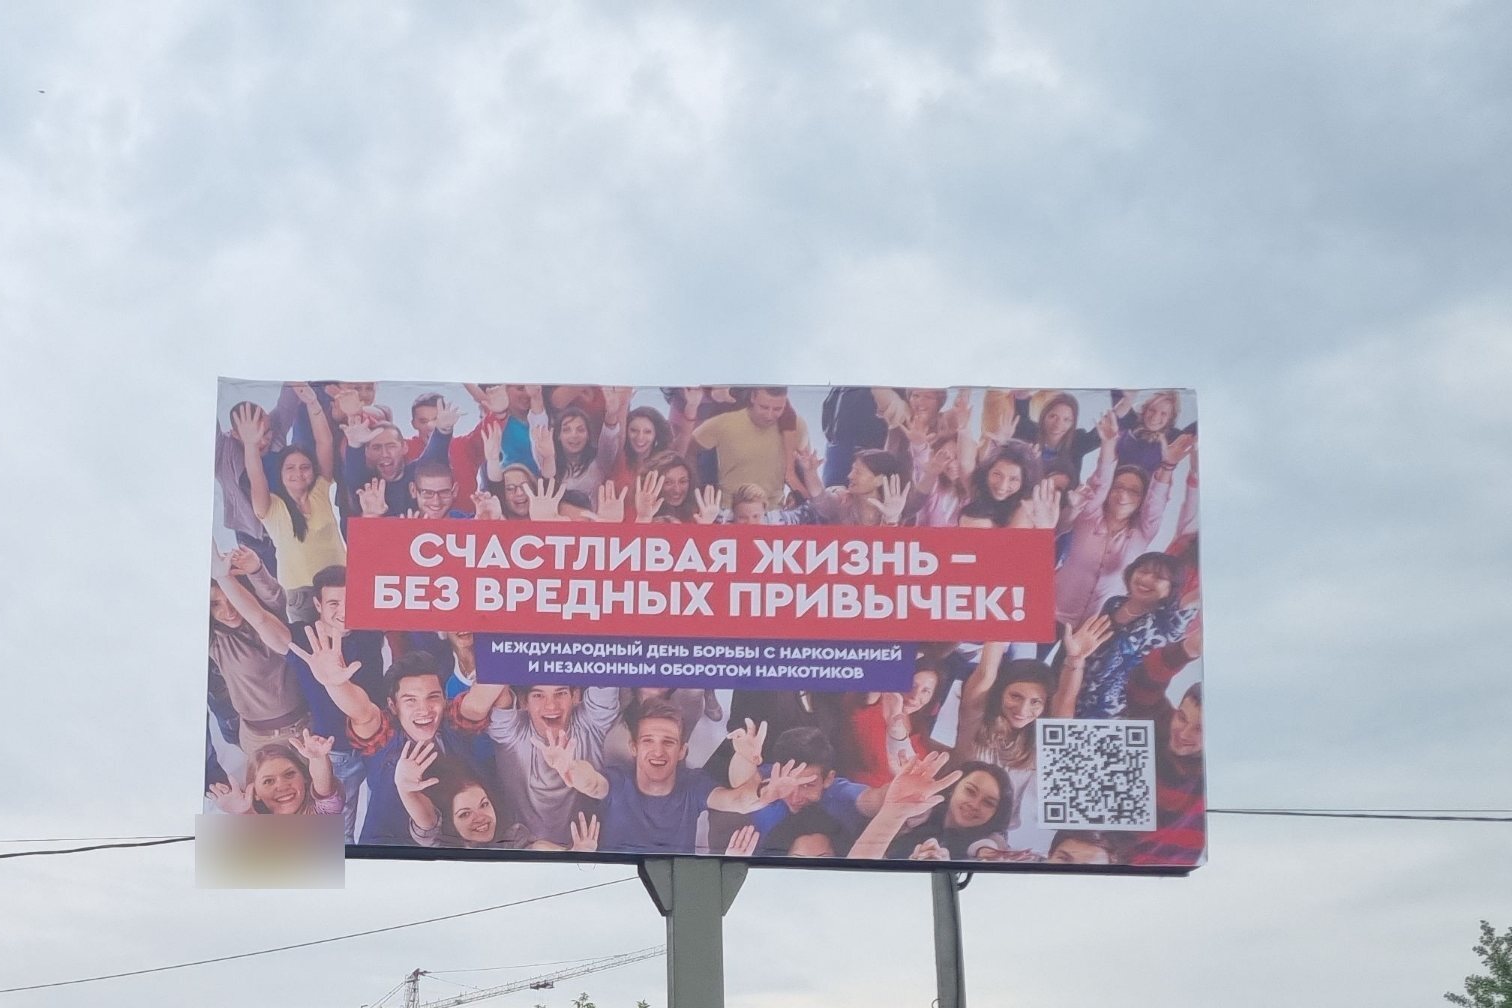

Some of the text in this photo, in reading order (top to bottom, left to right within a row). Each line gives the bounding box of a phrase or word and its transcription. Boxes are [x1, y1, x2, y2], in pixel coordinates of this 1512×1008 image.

[409, 532, 737, 573] СЧАСТЛИВАЯ
[752, 538, 939, 576] ЖИЗНЬ
[374, 574, 1026, 622] БЕЗ ВРЕДНЫХ ПРИВЫЧЕК!
[491, 640, 902, 661] МЕЖДУНАРОДНЫЙ ДЕНЬ БОРЬБЫ С НАРКОМАНИЕЙ
[528, 660, 864, 679] И НЕЗАКОННЫМ ОБОРОТОМ НАРКОТИКОВ
